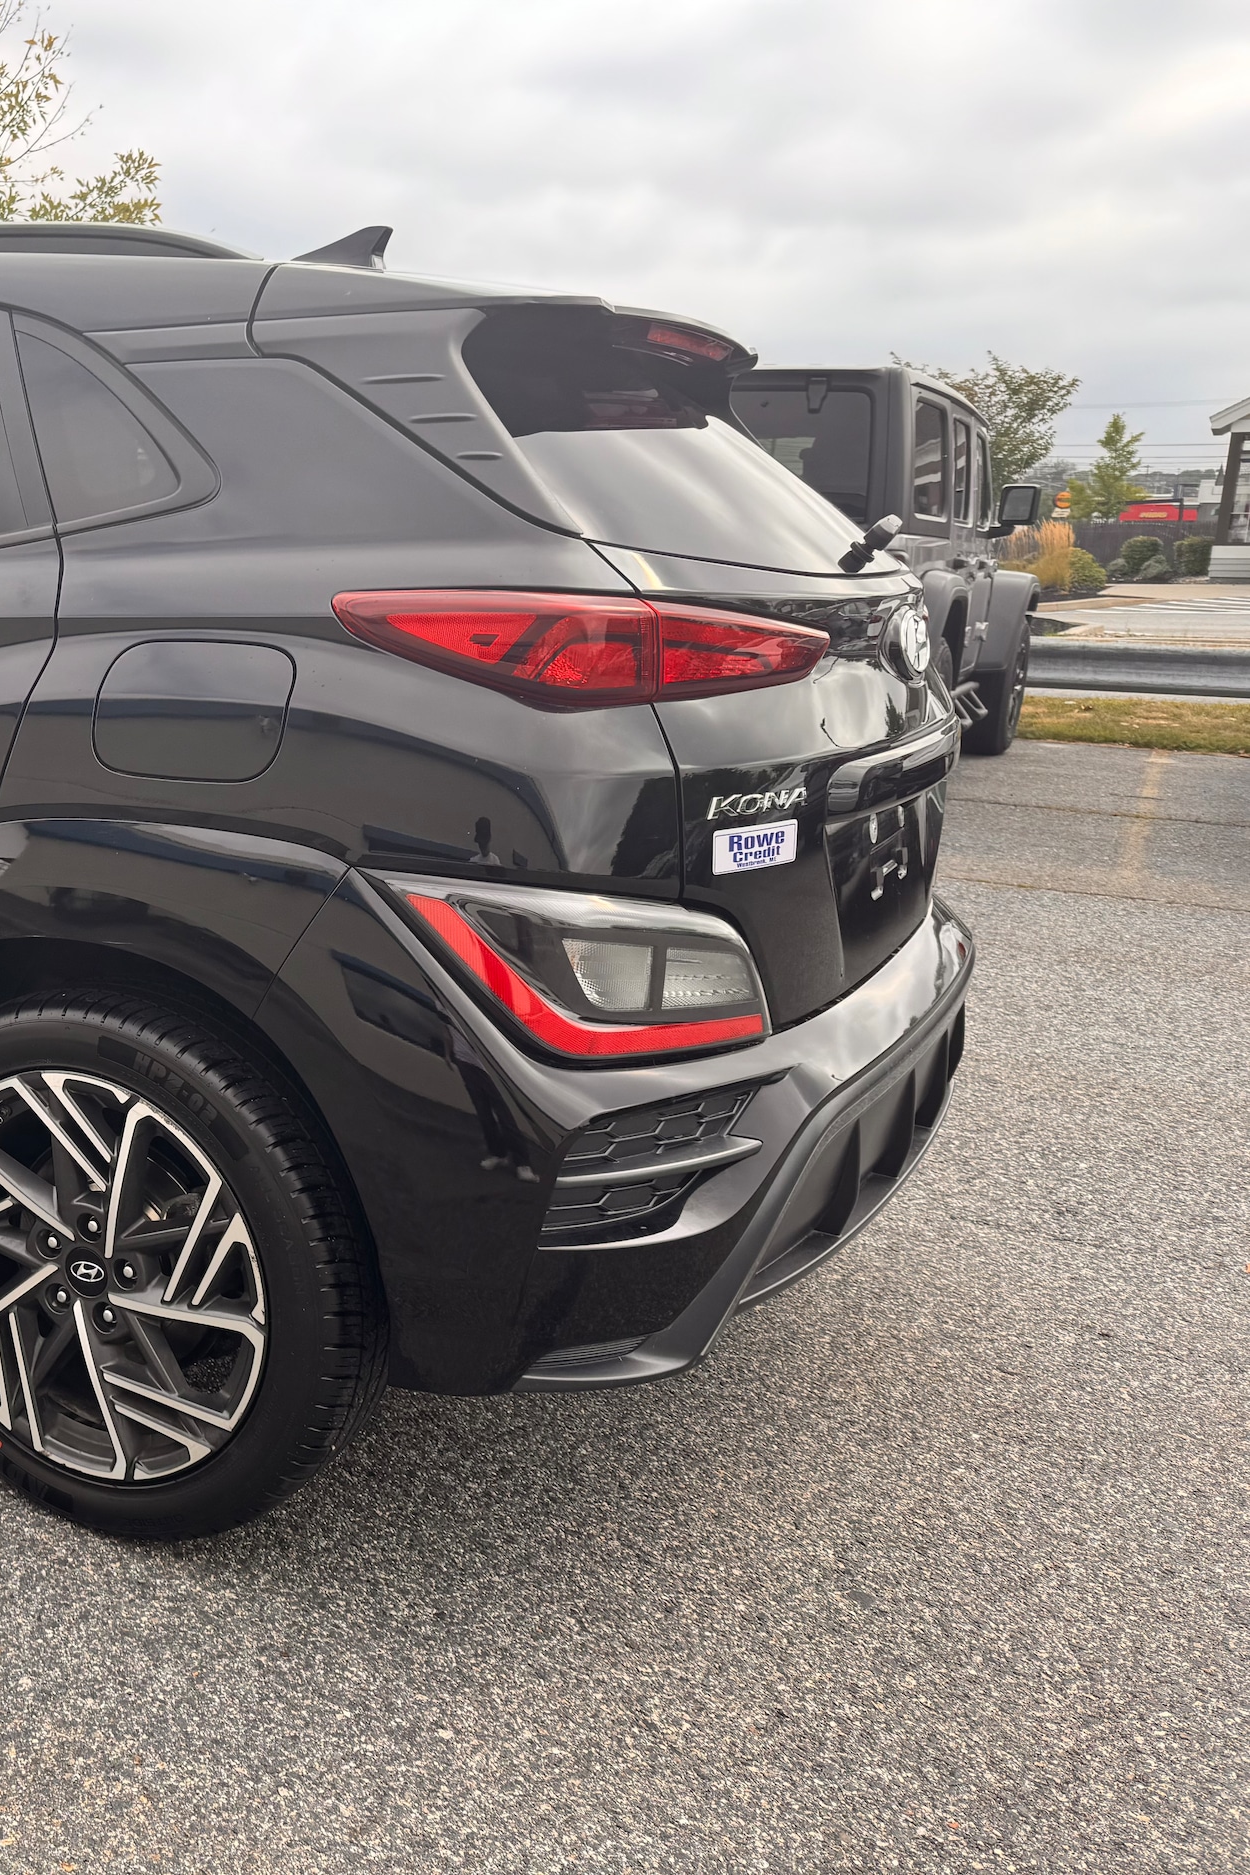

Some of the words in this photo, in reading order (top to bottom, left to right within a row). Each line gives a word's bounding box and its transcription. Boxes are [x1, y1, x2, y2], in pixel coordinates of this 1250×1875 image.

[707, 787, 808, 820] KONA
[729, 830, 785, 852] Rowe
[733, 845, 781, 863] Credit
